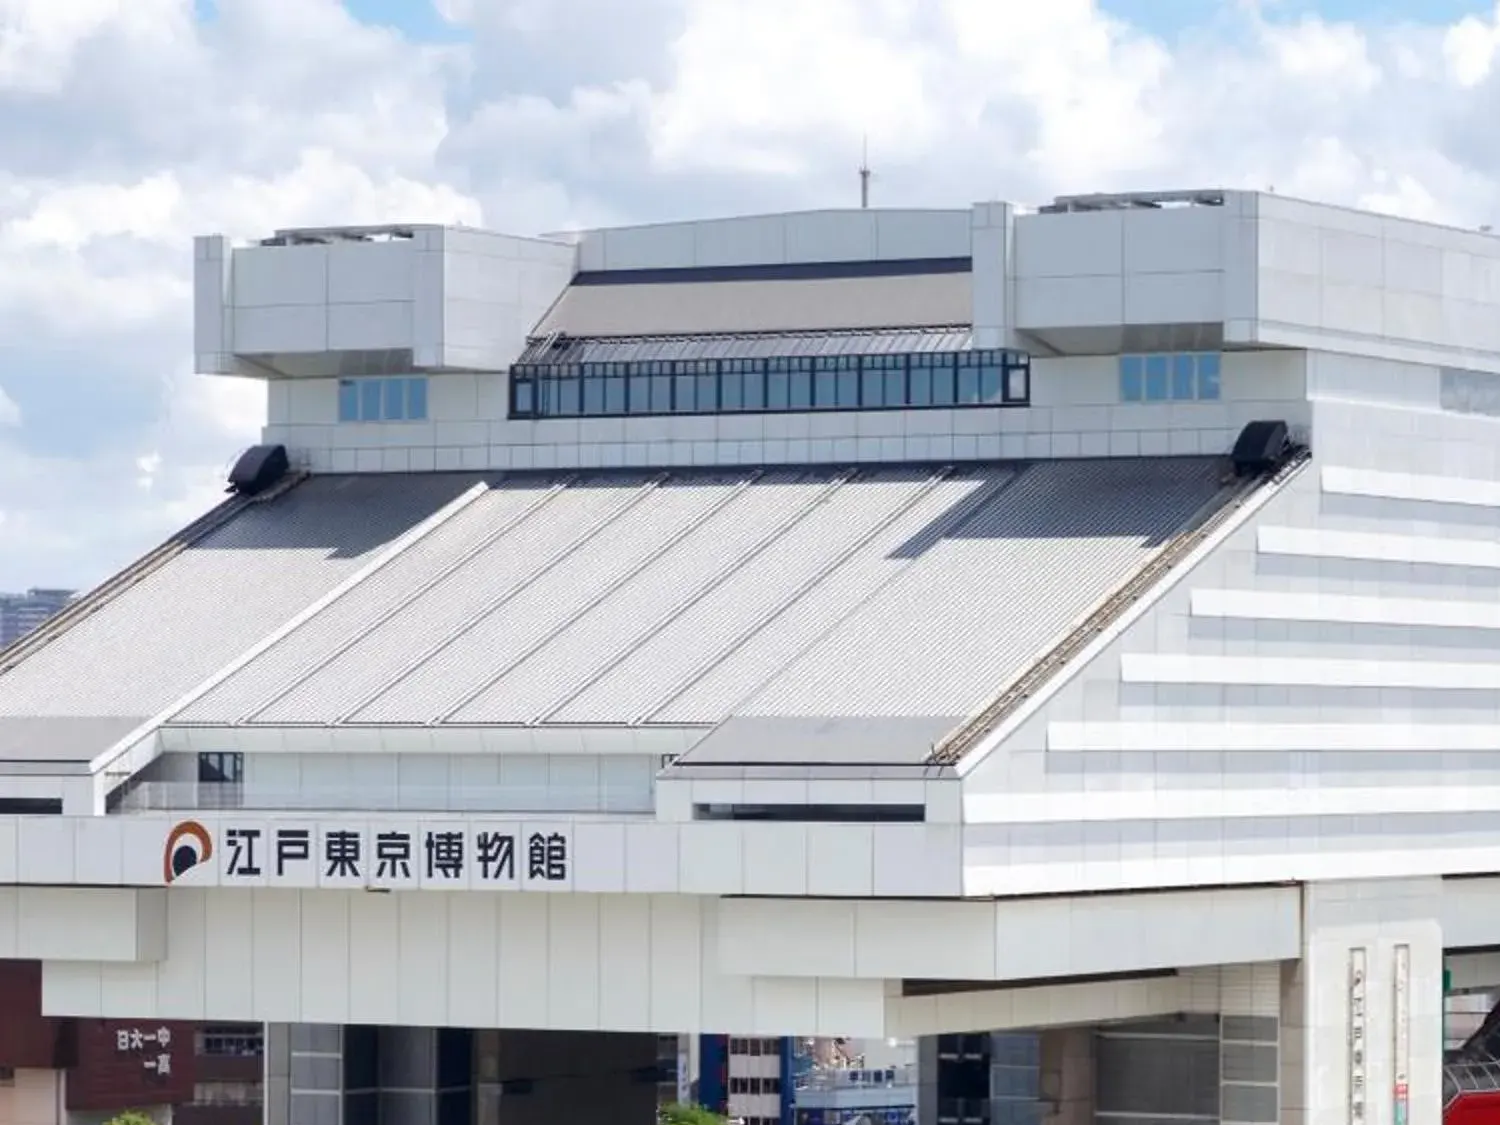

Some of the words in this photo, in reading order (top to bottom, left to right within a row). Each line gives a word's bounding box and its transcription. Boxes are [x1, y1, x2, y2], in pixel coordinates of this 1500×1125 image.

[225, 829, 567, 881] 江戸東京博物館
